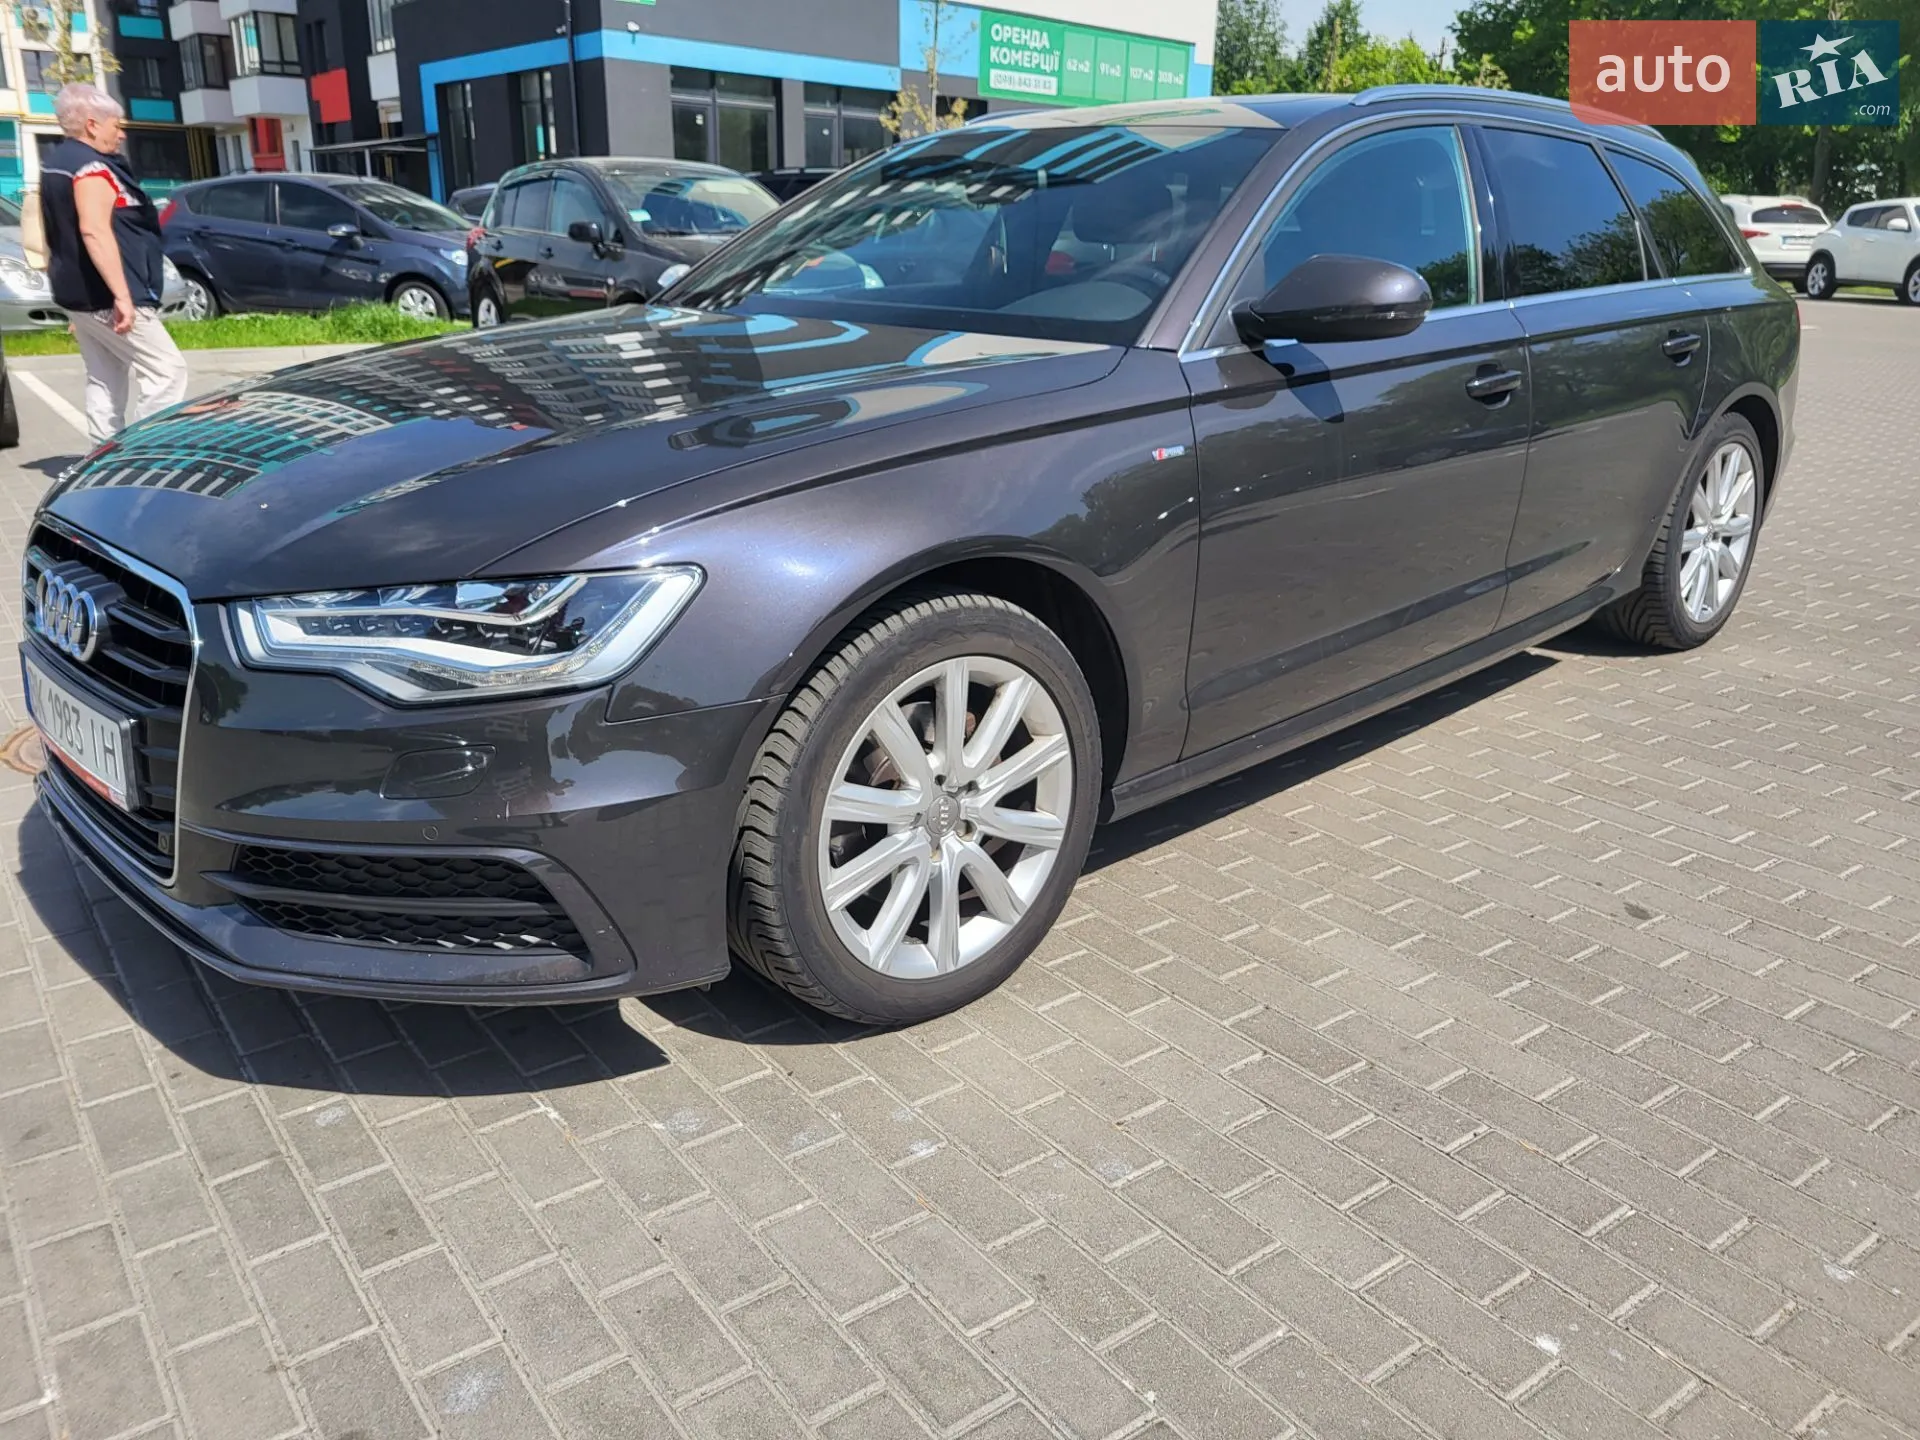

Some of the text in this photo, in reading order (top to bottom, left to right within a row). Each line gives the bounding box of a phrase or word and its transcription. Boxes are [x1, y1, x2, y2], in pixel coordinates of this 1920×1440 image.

[990, 23, 1051, 50] ОРЕНДА
[989, 45, 1061, 73] КОМЕРЦІЇ
[47, 687, 84, 756] 1983
[90, 718, 121, 783] IH
